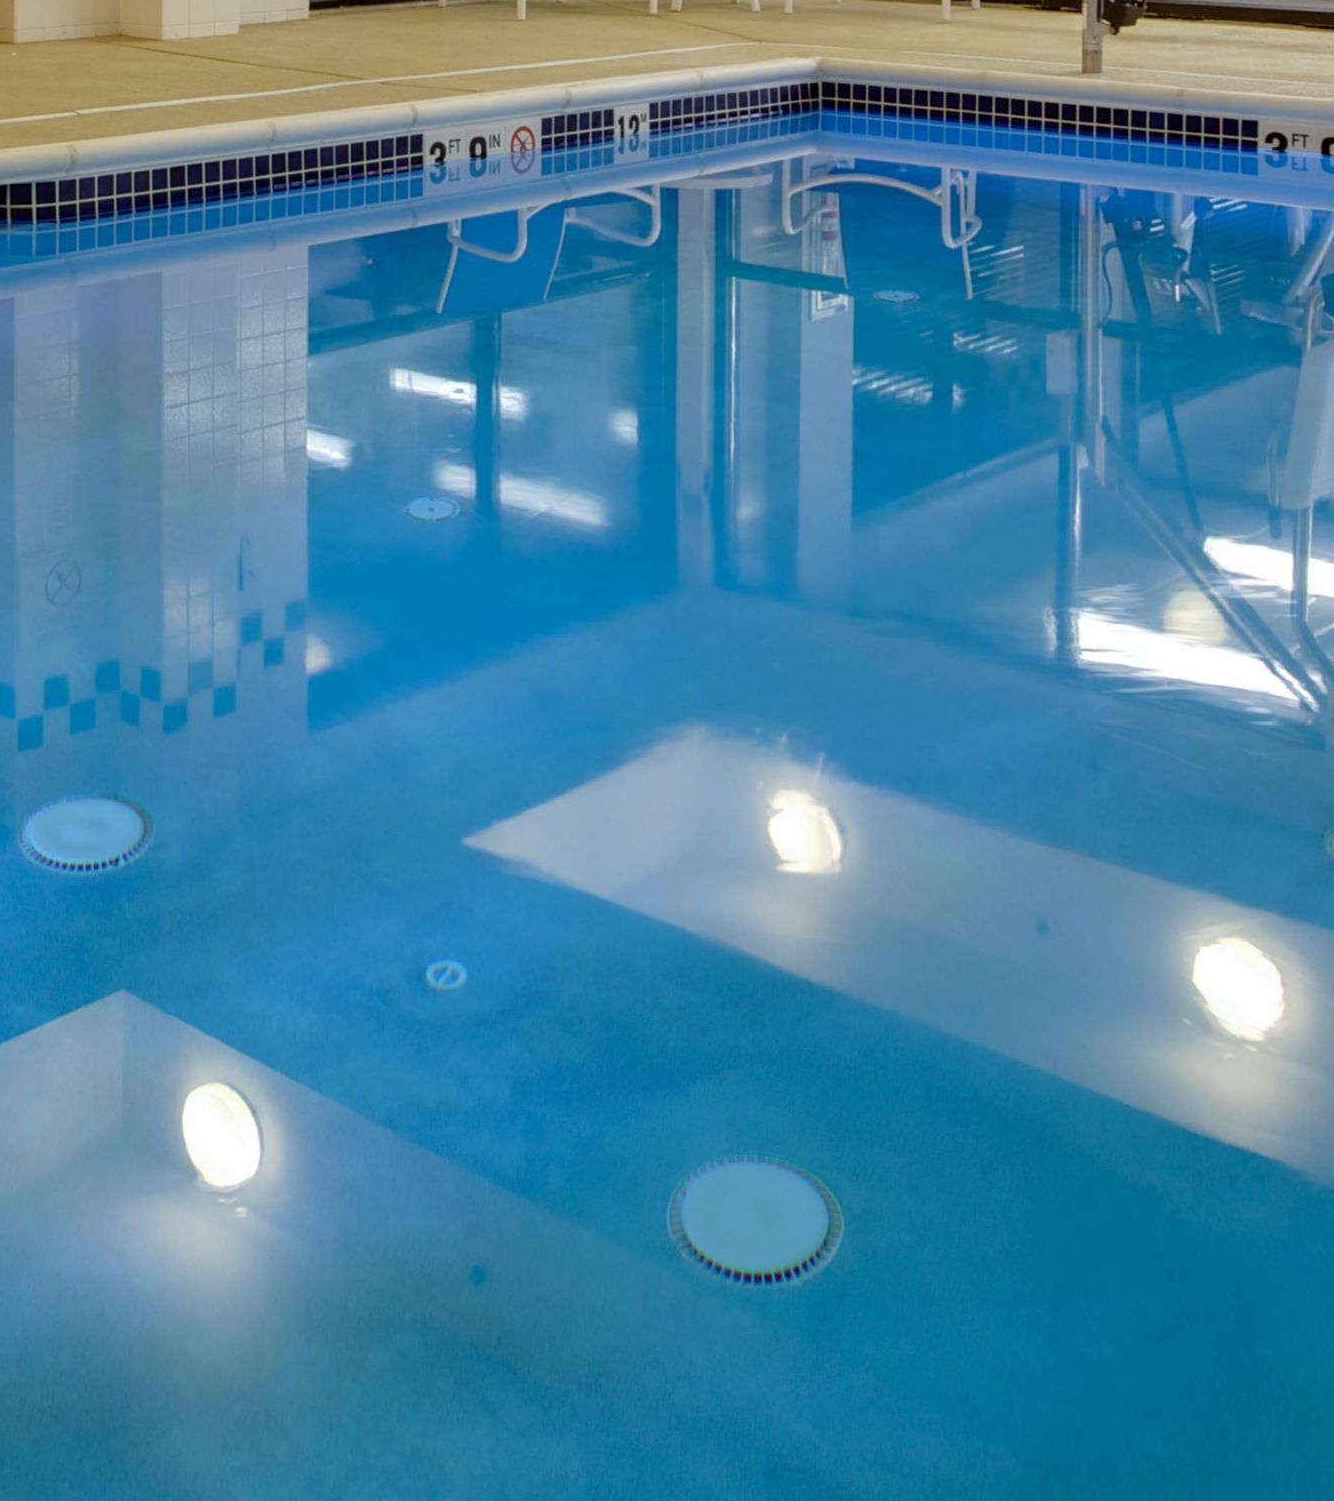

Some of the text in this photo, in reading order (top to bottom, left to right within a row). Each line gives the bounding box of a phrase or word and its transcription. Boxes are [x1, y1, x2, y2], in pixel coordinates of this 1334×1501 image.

[448, 139, 461, 154] FT
[489, 134, 500, 148] IN
[1292, 133, 1309, 148] FT
